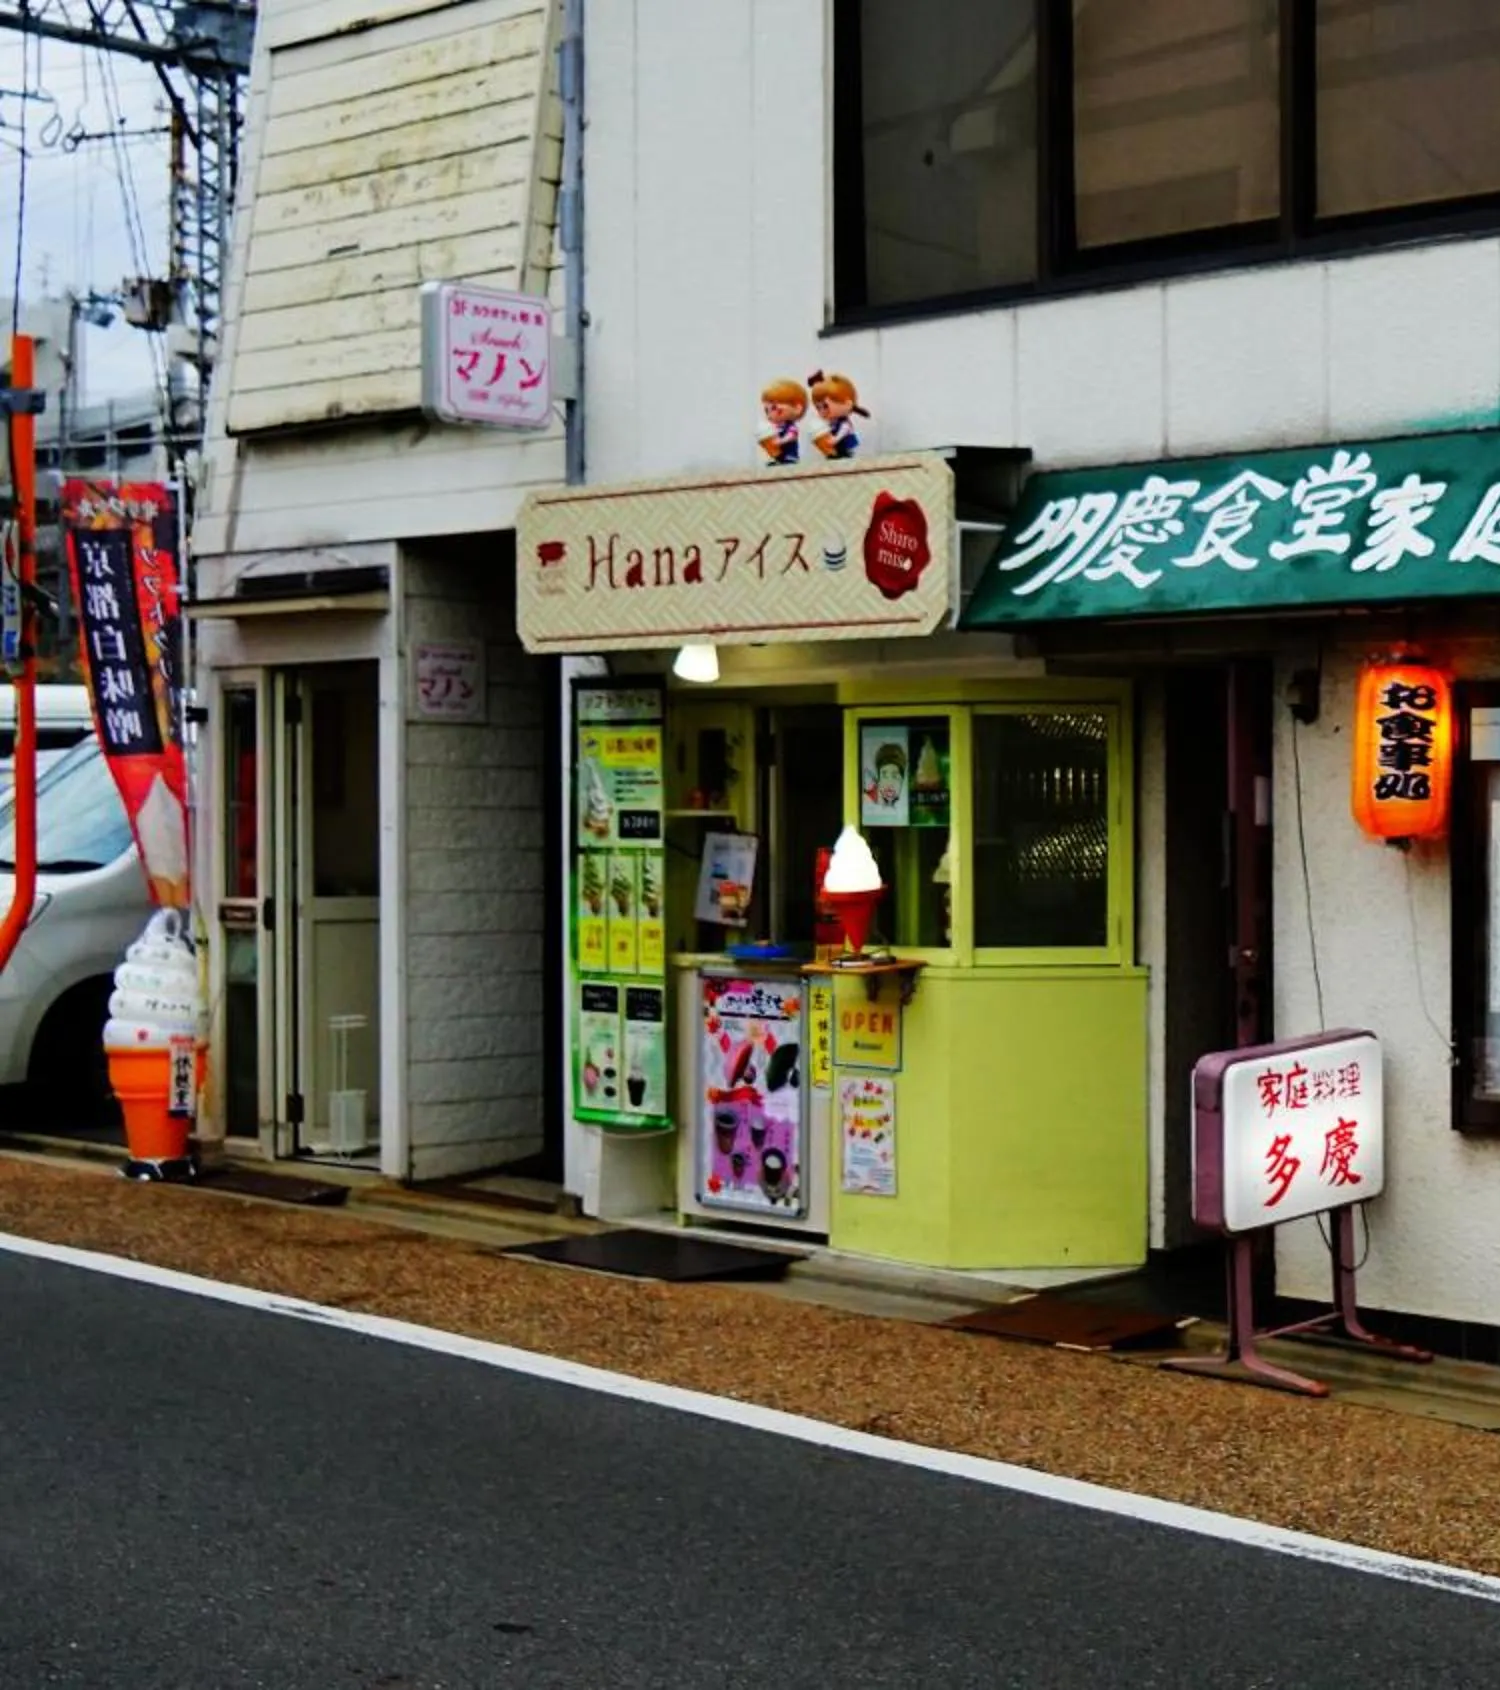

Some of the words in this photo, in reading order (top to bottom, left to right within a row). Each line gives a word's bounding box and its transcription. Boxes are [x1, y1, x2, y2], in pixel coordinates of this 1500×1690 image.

[453, 348, 547, 390] マノン
[585, 531, 704, 593] Hana
[714, 532, 811, 583] アイス
[840, 1011, 895, 1035] OPEN
[1257, 1061, 1361, 1118] 家庭料理
[1264, 1116, 1362, 1208] 多慶
